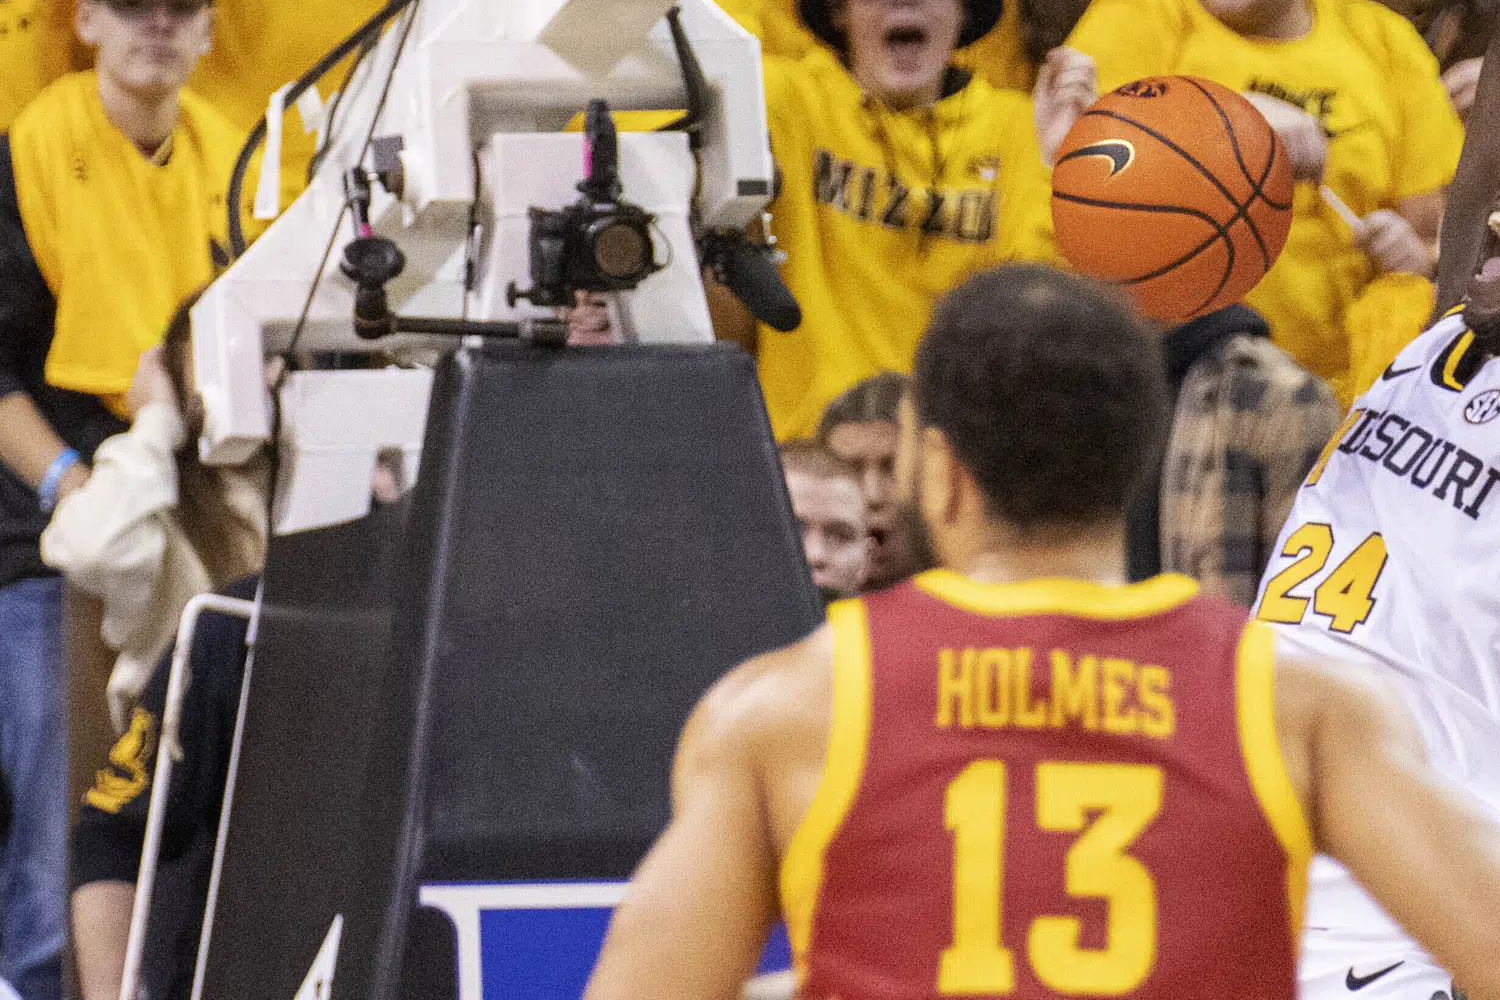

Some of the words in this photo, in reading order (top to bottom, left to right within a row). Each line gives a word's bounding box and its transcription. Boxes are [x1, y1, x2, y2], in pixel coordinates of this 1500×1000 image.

[1256, 522, 1388, 634] 24
[936, 646, 1176, 739] HOLMES
[938, 758, 1164, 995] 13
